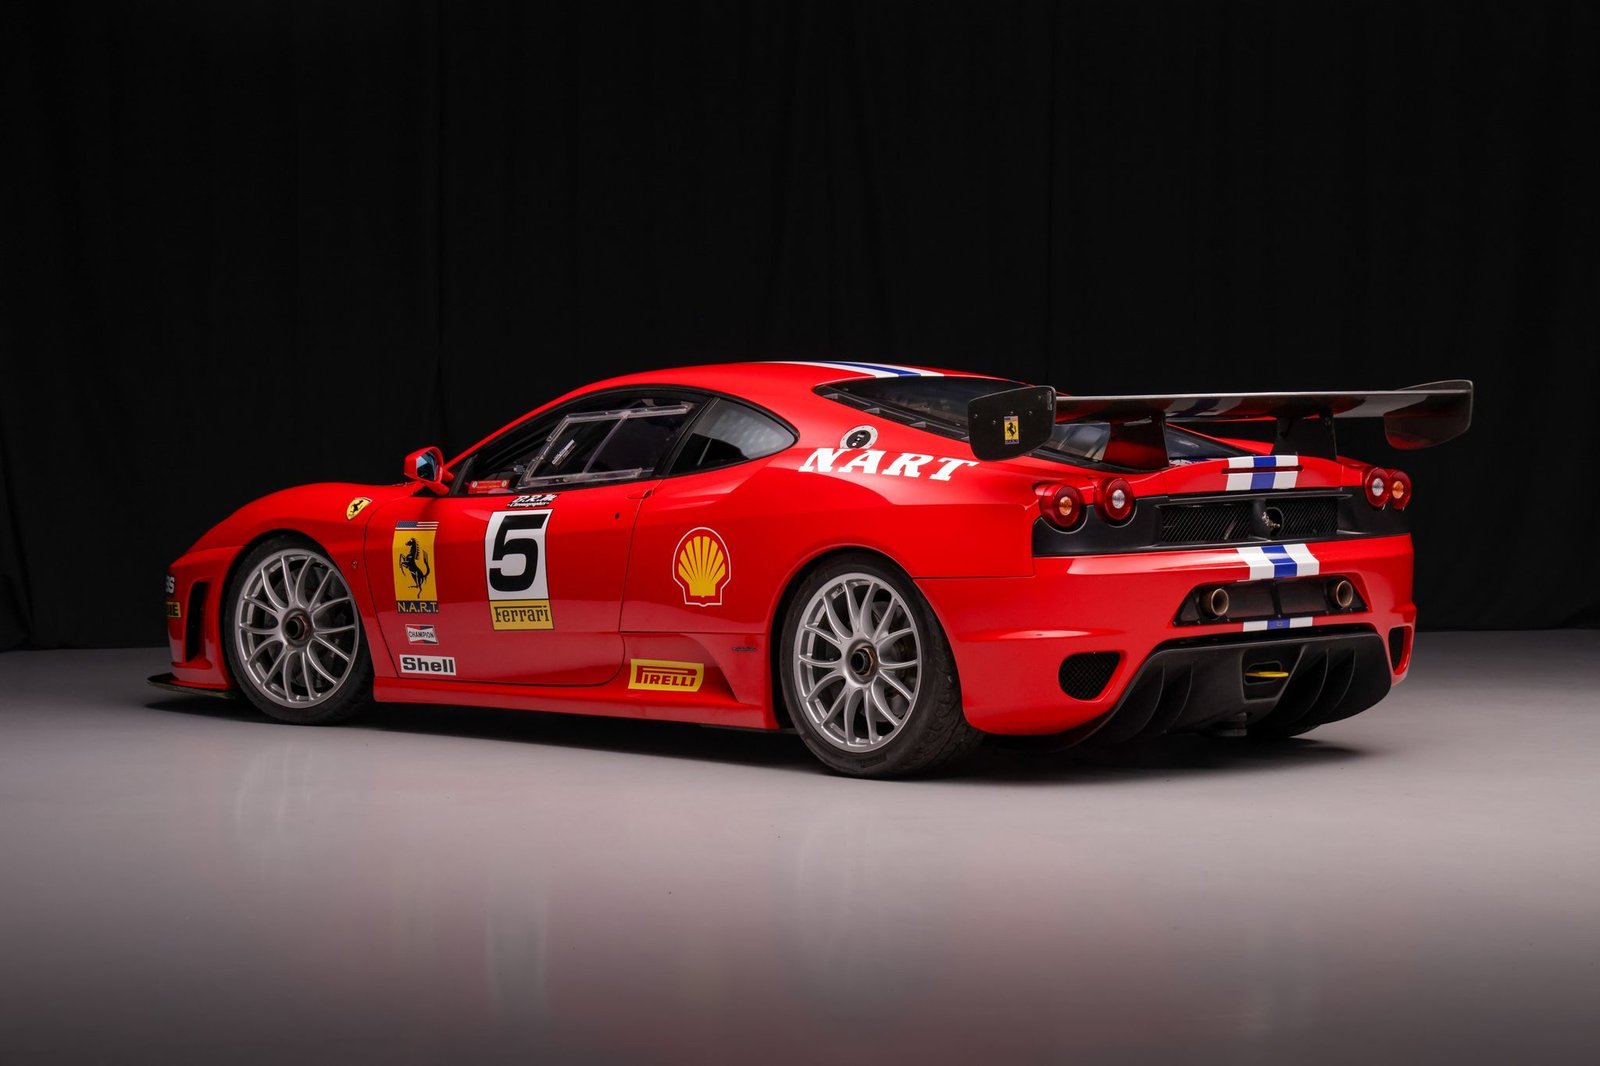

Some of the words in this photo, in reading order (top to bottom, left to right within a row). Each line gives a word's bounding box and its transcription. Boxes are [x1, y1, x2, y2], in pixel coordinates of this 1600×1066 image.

[798, 448, 980, 481] NART
[489, 513, 549, 592] 5
[397, 602, 439, 613] N.A.R.T.
[494, 605, 550, 623] Ferrari
[408, 630, 435, 639] CHAMPION
[402, 657, 455, 673] Shell
[635, 665, 698, 687] PIRELLI
